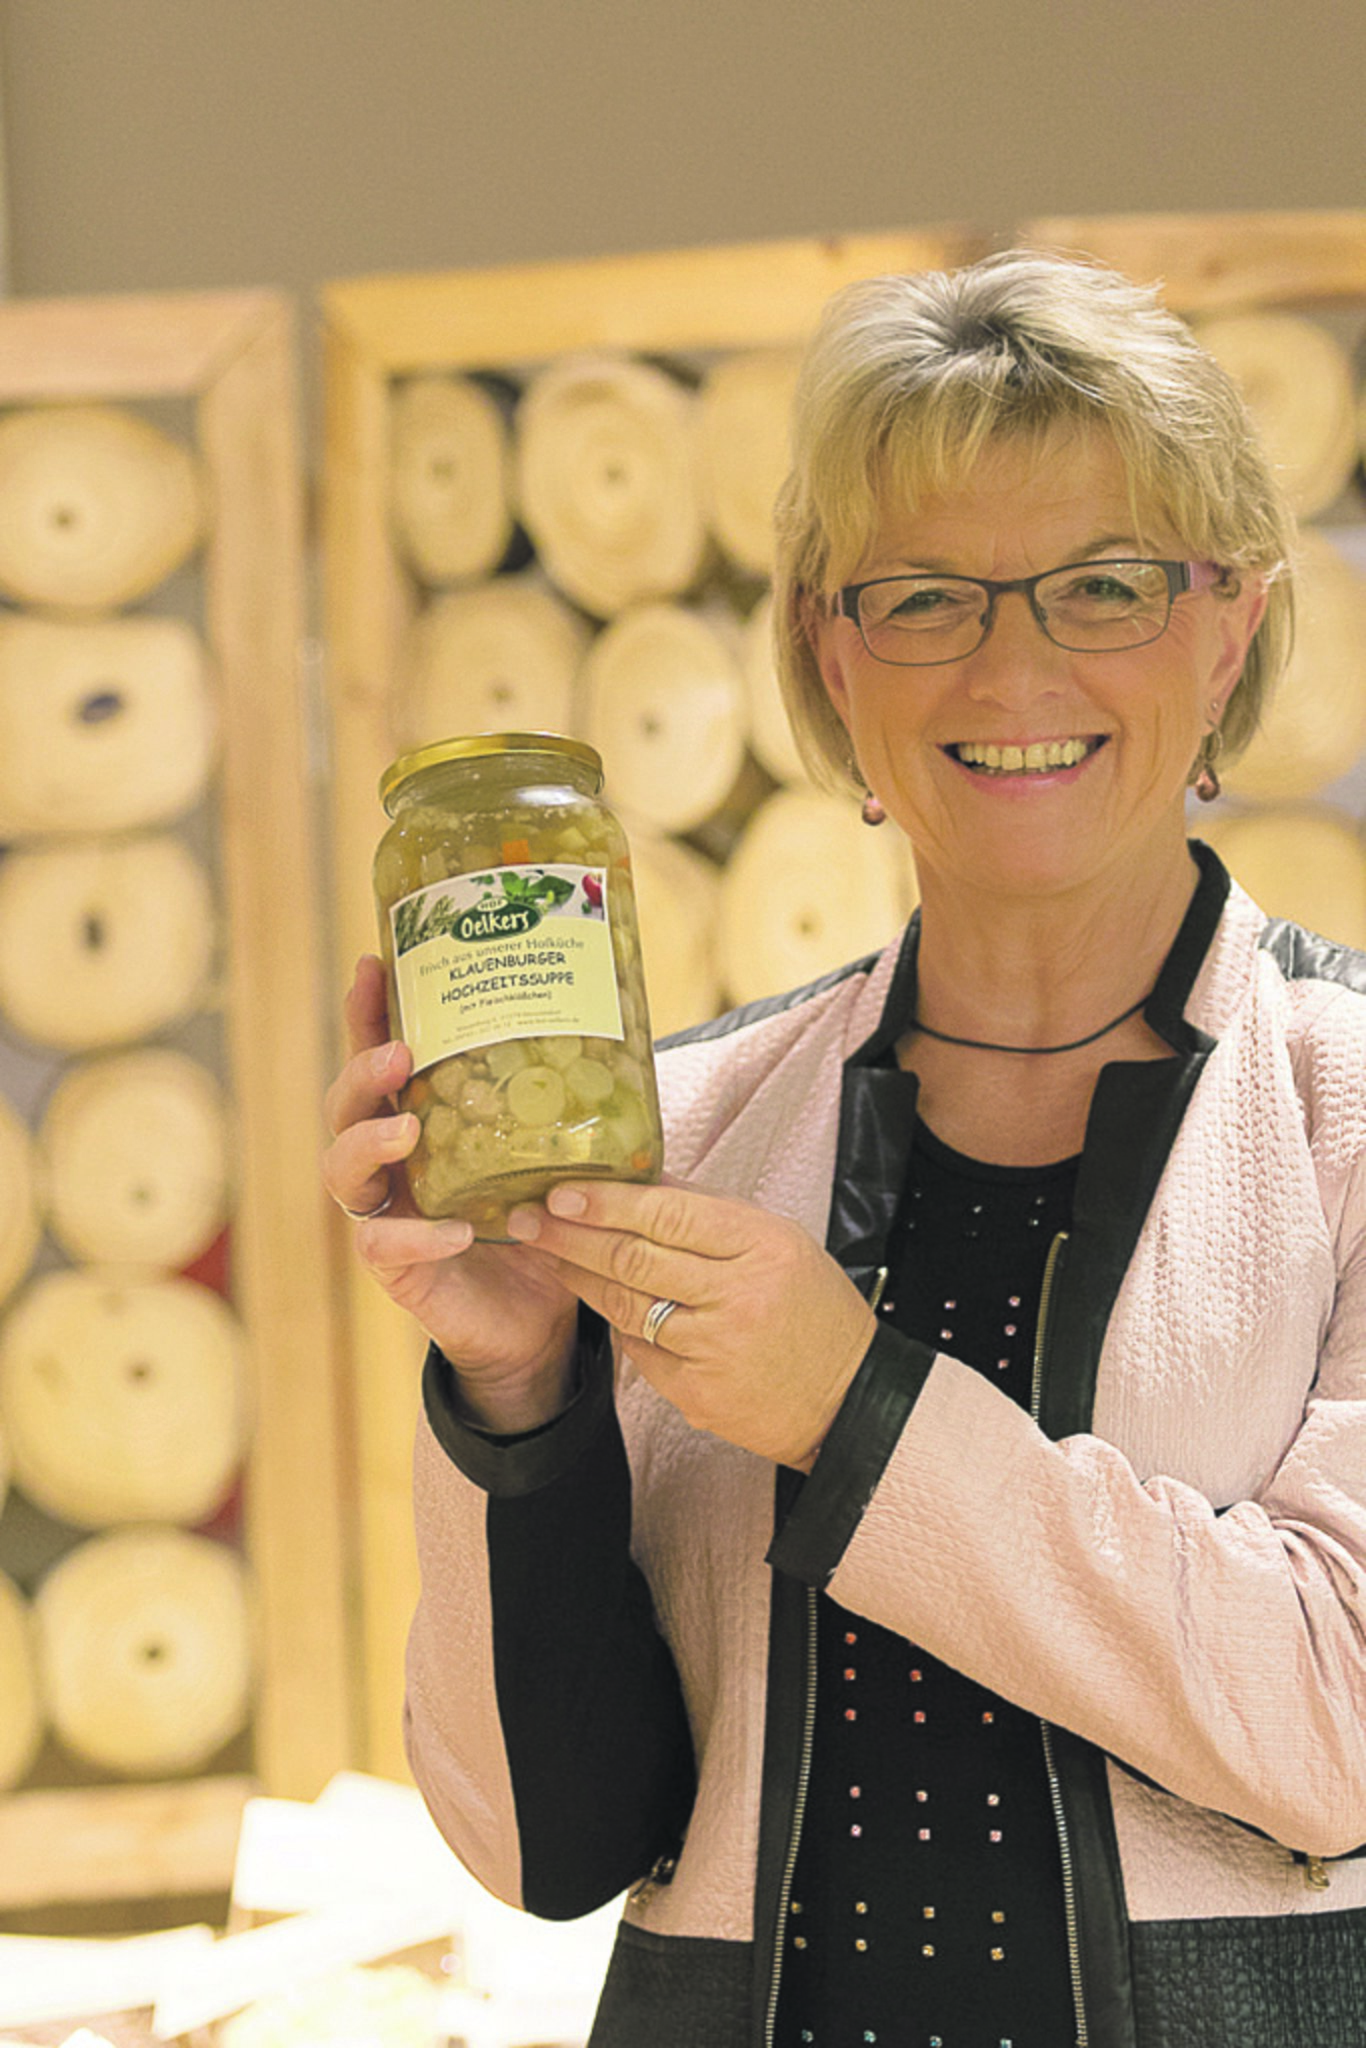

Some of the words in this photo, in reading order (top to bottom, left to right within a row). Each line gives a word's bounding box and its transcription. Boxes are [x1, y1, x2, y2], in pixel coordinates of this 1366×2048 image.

[461, 910, 529, 939] Oelkers
[449, 951, 566, 982] KLAUENBURGER
[452, 952, 473, 964] aus
[476, 941, 522, 957] unserer
[441, 971, 575, 1005] HOCHZEITSSUPPE
